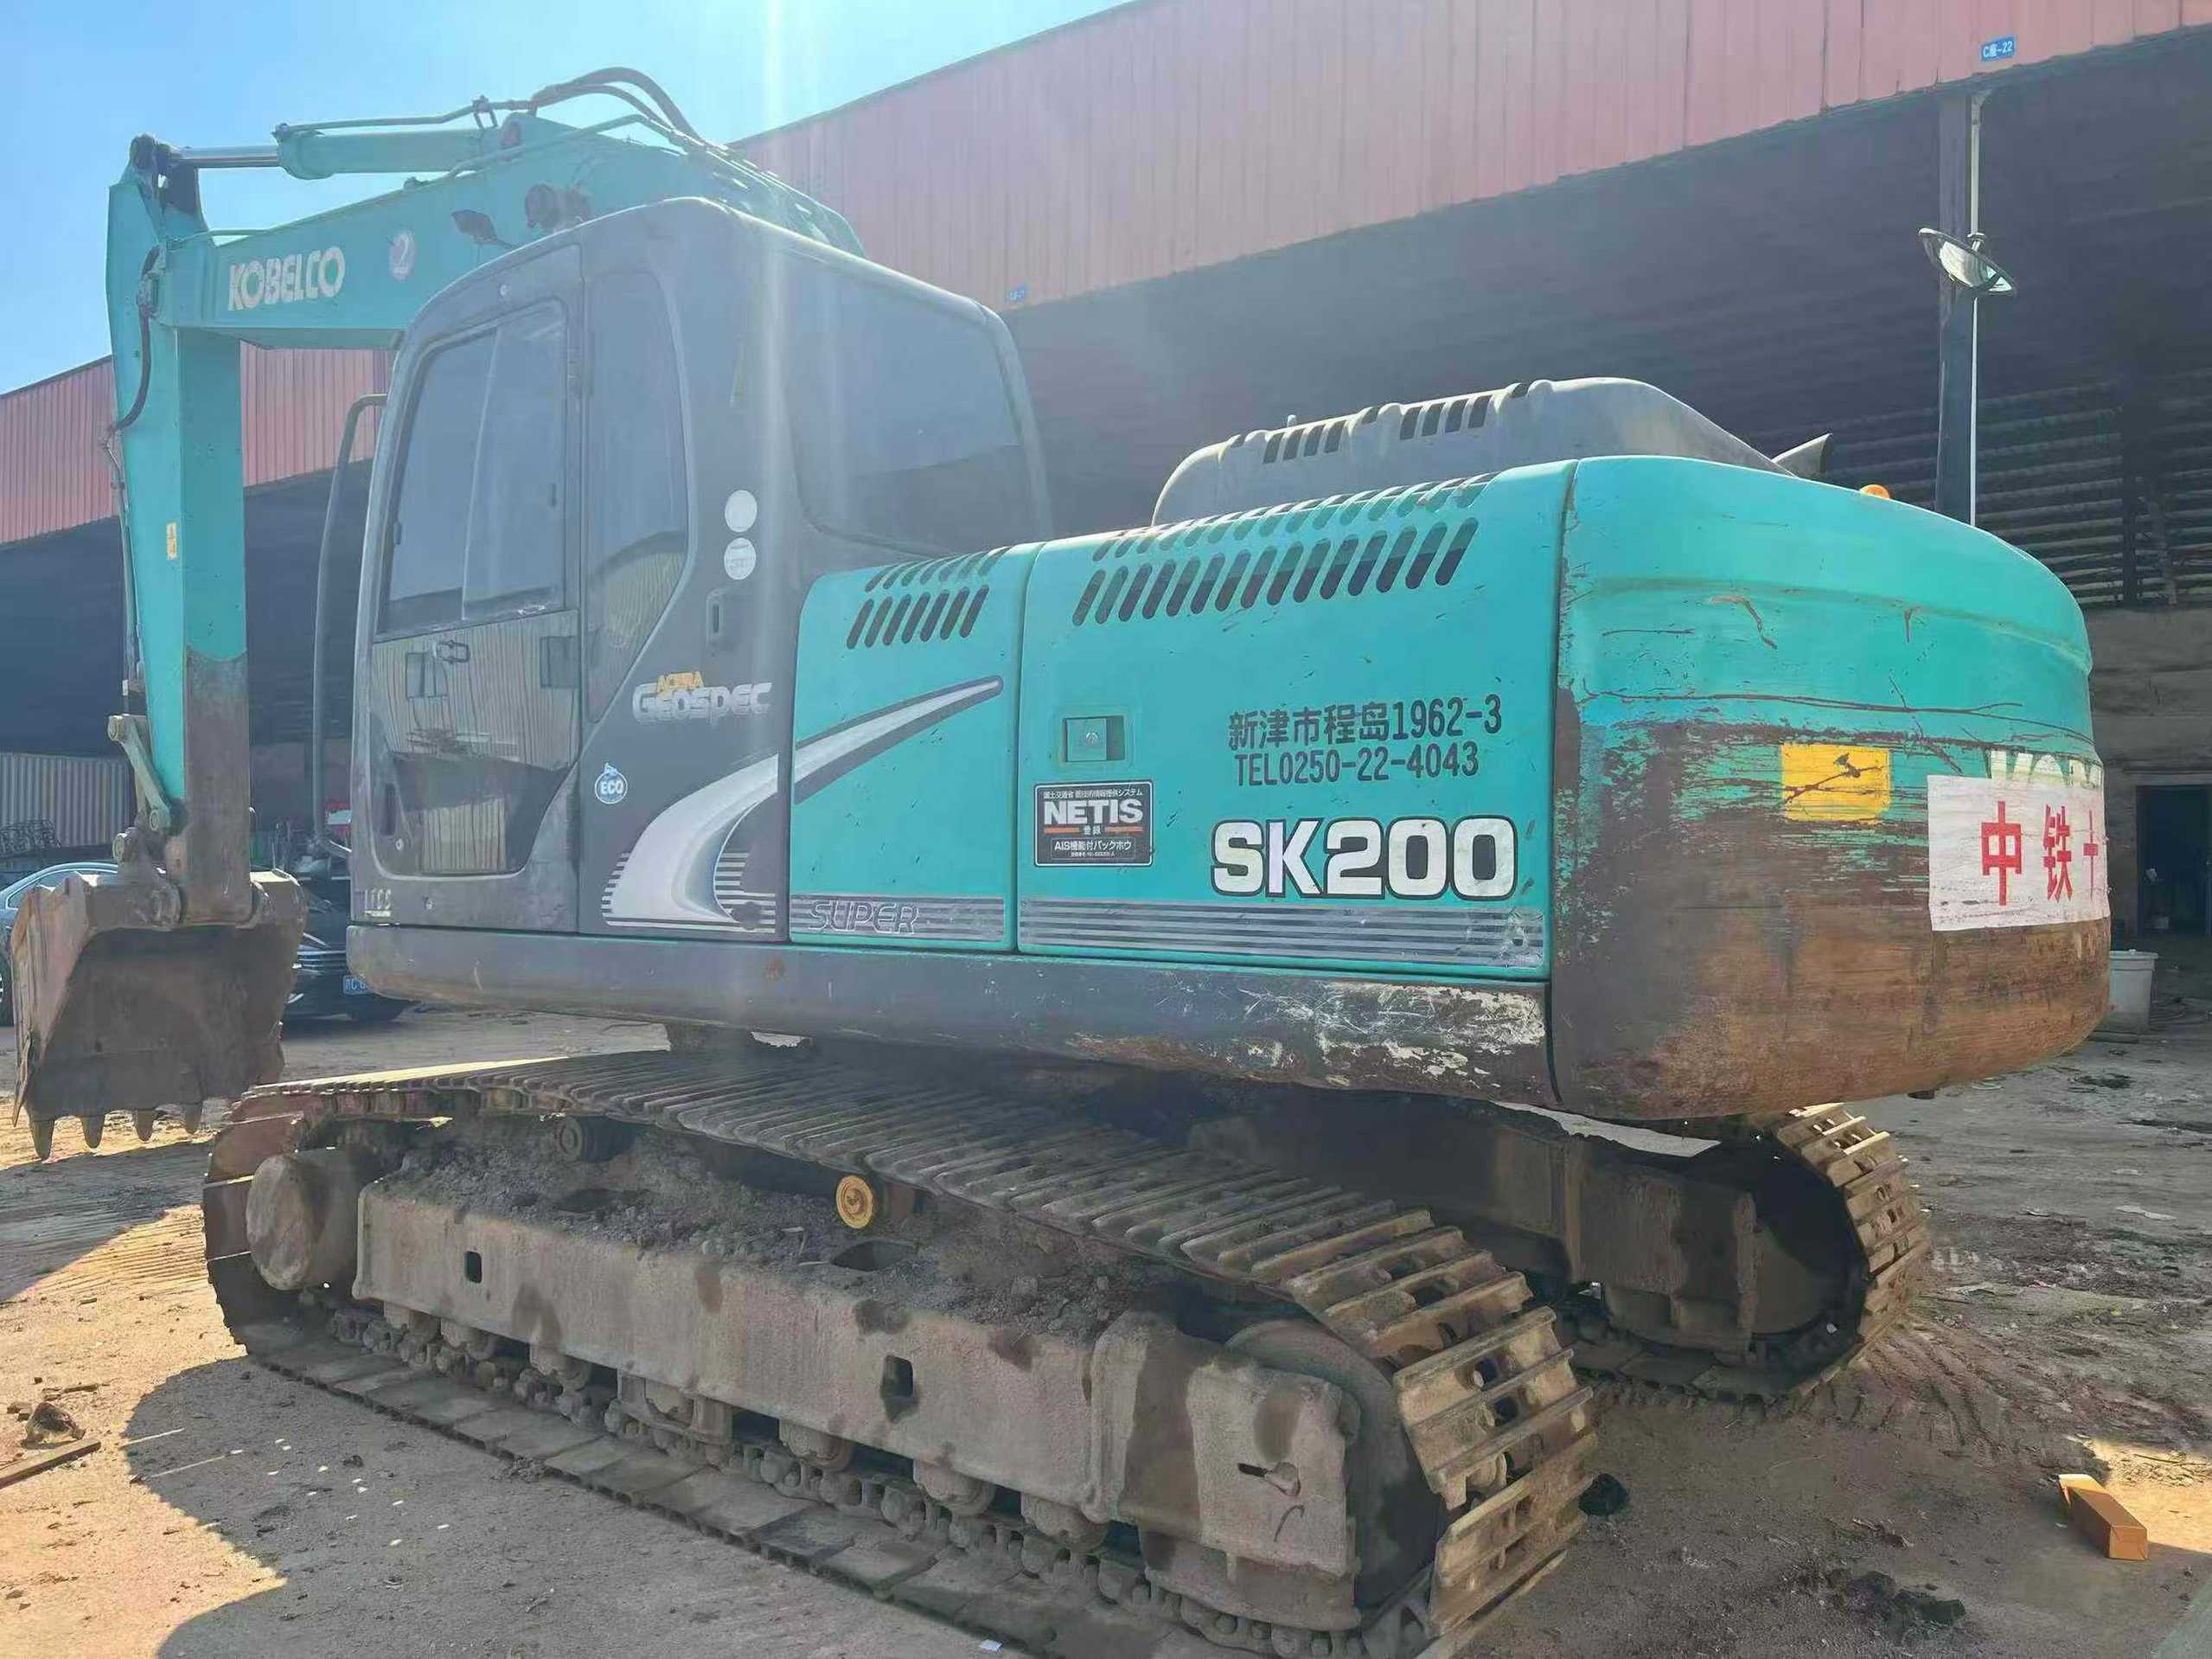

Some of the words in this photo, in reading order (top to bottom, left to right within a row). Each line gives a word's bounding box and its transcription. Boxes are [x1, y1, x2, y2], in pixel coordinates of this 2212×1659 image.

[228, 247, 345, 311] KOBELCO
[600, 778, 623, 795] ECO
[1044, 798, 1143, 825] NETIS
[1212, 815, 1518, 901] SK200
[808, 899, 919, 935] SUPER
